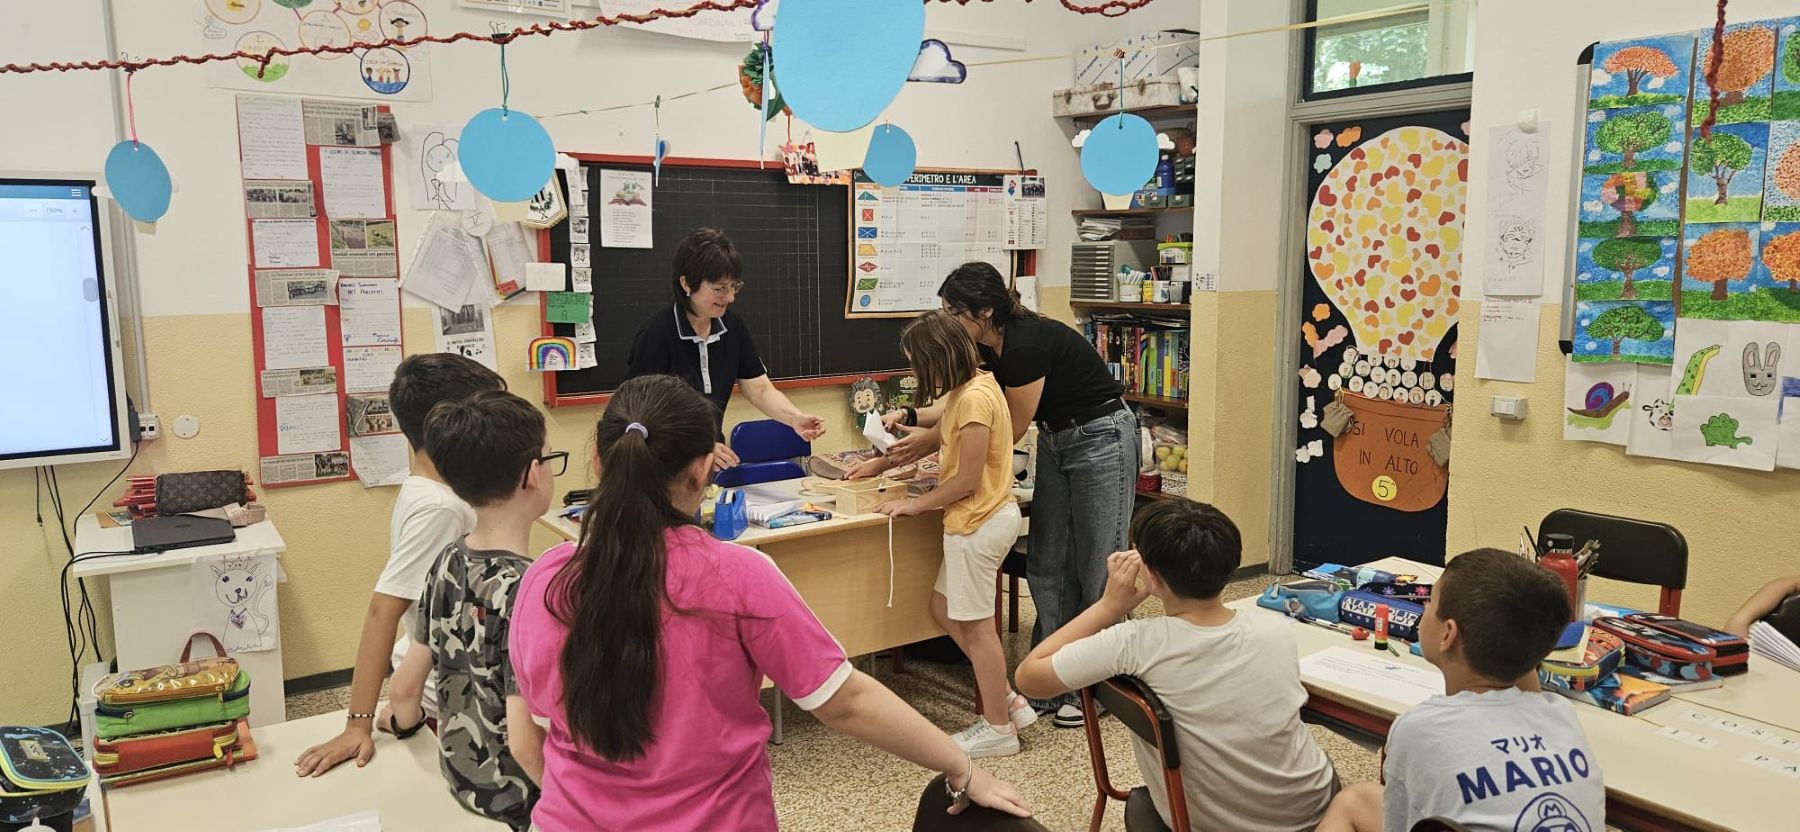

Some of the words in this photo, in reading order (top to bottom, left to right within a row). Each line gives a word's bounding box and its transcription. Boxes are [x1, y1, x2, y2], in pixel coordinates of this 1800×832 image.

[945, 174, 951, 183] E
[952, 175, 977, 184] L'AREA
[1384, 426, 1419, 448] VOLA
[1359, 449, 1371, 465] IN
[1384, 455, 1418, 475] ALTO
[1490, 733, 1546, 754] マリオ
[1456, 748, 1589, 805] MARIO
